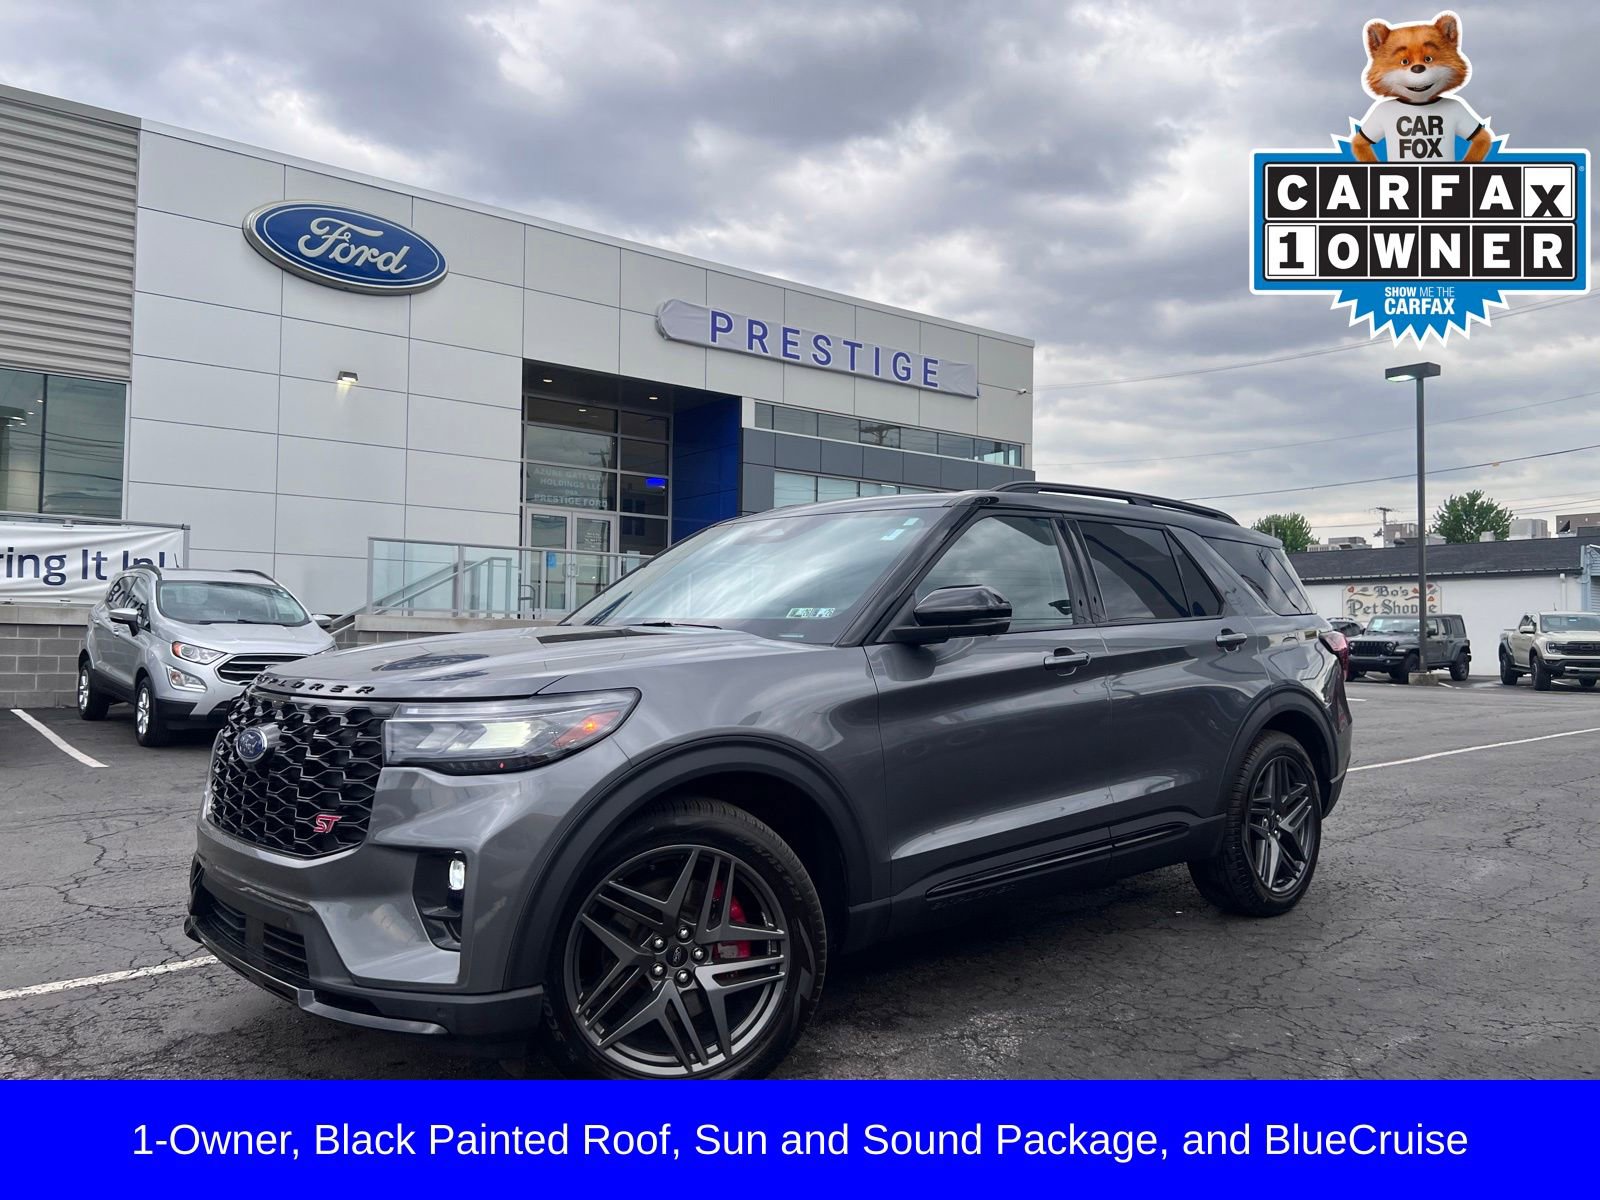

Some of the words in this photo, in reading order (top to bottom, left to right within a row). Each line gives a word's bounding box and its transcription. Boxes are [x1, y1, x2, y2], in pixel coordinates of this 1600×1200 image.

[298, 217, 410, 274] Ford
[709, 309, 939, 389] PRESTIGE
[81, 549, 108, 580] It
[1373, 585, 1409, 598] Bo's
[1346, 598, 1379, 617] Pet
[1381, 598, 1438, 615] Shope
[313, 814, 342, 834] ST
